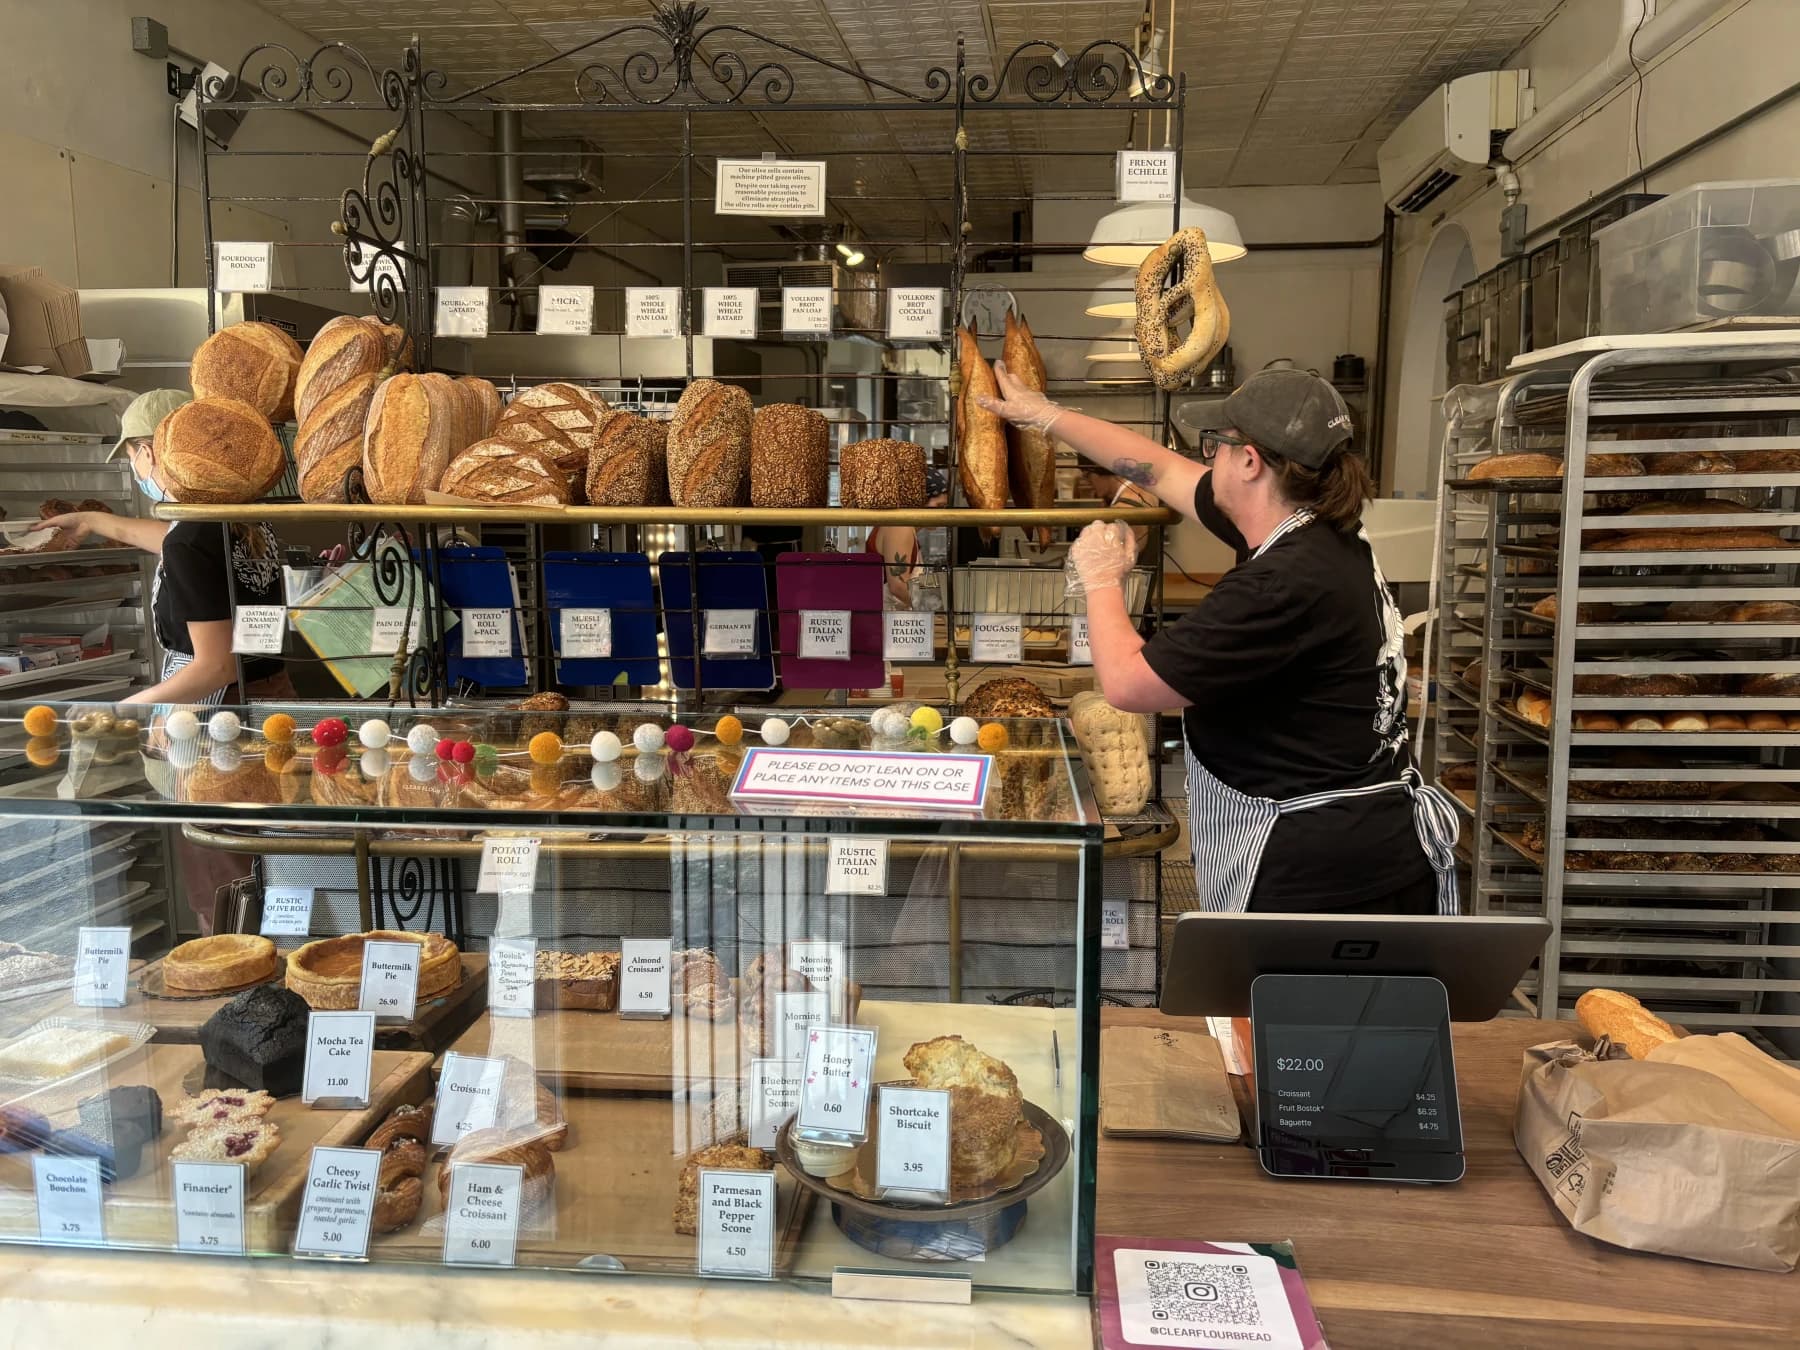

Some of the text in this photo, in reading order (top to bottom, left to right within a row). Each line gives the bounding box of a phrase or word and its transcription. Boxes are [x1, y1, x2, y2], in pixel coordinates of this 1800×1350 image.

[1129, 159, 1167, 167] FRENCH
[1127, 168, 1168, 176] ECHELLE
[221, 255, 266, 263] SOURDOUGH
[440, 299, 485, 307] SOURDGH
[640, 300, 665, 308] WHOLE
[640, 307, 665, 315] WHEAT
[717, 307, 743, 315] WHEAT
[472, 612, 502, 620] POTATO
[810, 618, 842, 626] RUSTIC
[893, 619, 925, 627] RUSTIC
[474, 628, 500, 636] 6-PACK
[808, 626, 843, 634] ITALIAN
[975, 625, 1020, 633] FOUGASSE
[815, 634, 837, 643] PAVÉ
[892, 636, 925, 644] ROUND
[767, 760, 964, 778] PLEASE DO NOT LEAN ON OR
[753, 772, 971, 793] PLACE ANY ITEMS ON THIS CASE
[491, 846, 530, 855] POTATO
[839, 847, 876, 857] RUSTIC
[496, 856, 522, 865] ROLL
[836, 856, 878, 867] ITALIAN
[843, 866, 870, 877] ROLL
[275, 897, 303, 905] RUSTIC
[266, 904, 290, 912] OLIVE
[85, 947, 123, 955] Buttermilk
[631, 956, 661, 964] Almond
[800, 956, 832, 965] Morning
[371, 961, 413, 971] Buttermilk
[800, 965, 833, 973] Bun with
[385, 972, 397, 980] Pie
[638, 991, 653, 999] 4.50
[378, 998, 398, 1006] 26.90
[784, 1012, 821, 1022] Morning
[317, 1036, 364, 1045] Mocha Tea
[328, 1047, 351, 1056] Cake
[822, 1053, 853, 1067] Honey
[1276, 1057, 1324, 1072] $22.00
[822, 1066, 851, 1078] Butter
[327, 1078, 348, 1086] 11.00
[450, 1082, 490, 1096] Croissant
[1278, 1089, 1436, 1101] Croissant $4.25
[768, 1099, 795, 1108] Scone
[823, 1103, 842, 1113] 0.60
[1278, 1104, 1296, 1112] Fruit
[889, 1105, 940, 1118] Shortcake
[455, 1121, 473, 1131] 4.25
[896, 1119, 932, 1130] Biscuit
[1279, 1118, 1439, 1130] Baguette $4.75
[903, 1162, 923, 1172] 3.95
[326, 1165, 361, 1180] Cheesy
[46, 1173, 88, 1184] Chocolate
[49, 1183, 87, 1193] Bouchon
[312, 1177, 371, 1191] Garlic Twist
[467, 1182, 504, 1195] Ham &
[712, 1184, 762, 1196] Parmesan
[315, 1195, 361, 1205] croissant with
[466, 1195, 503, 1208] Cheese
[711, 1197, 763, 1209] and Black
[334, 1207, 367, 1216] parmesan,
[459, 1207, 507, 1221] Croissant
[719, 1210, 755, 1223] Pepper
[313, 1214, 338, 1223] roasted
[61, 1223, 81, 1232] 3.75
[721, 1222, 752, 1234] Scone
[199, 1236, 219, 1246] 3.75
[322, 1232, 342, 1242] 5.00
[470, 1239, 491, 1250] 6.00
[726, 1246, 747, 1257] 4.50
[1150, 1326, 1272, 1342] @CLEARFLOURBREAD
